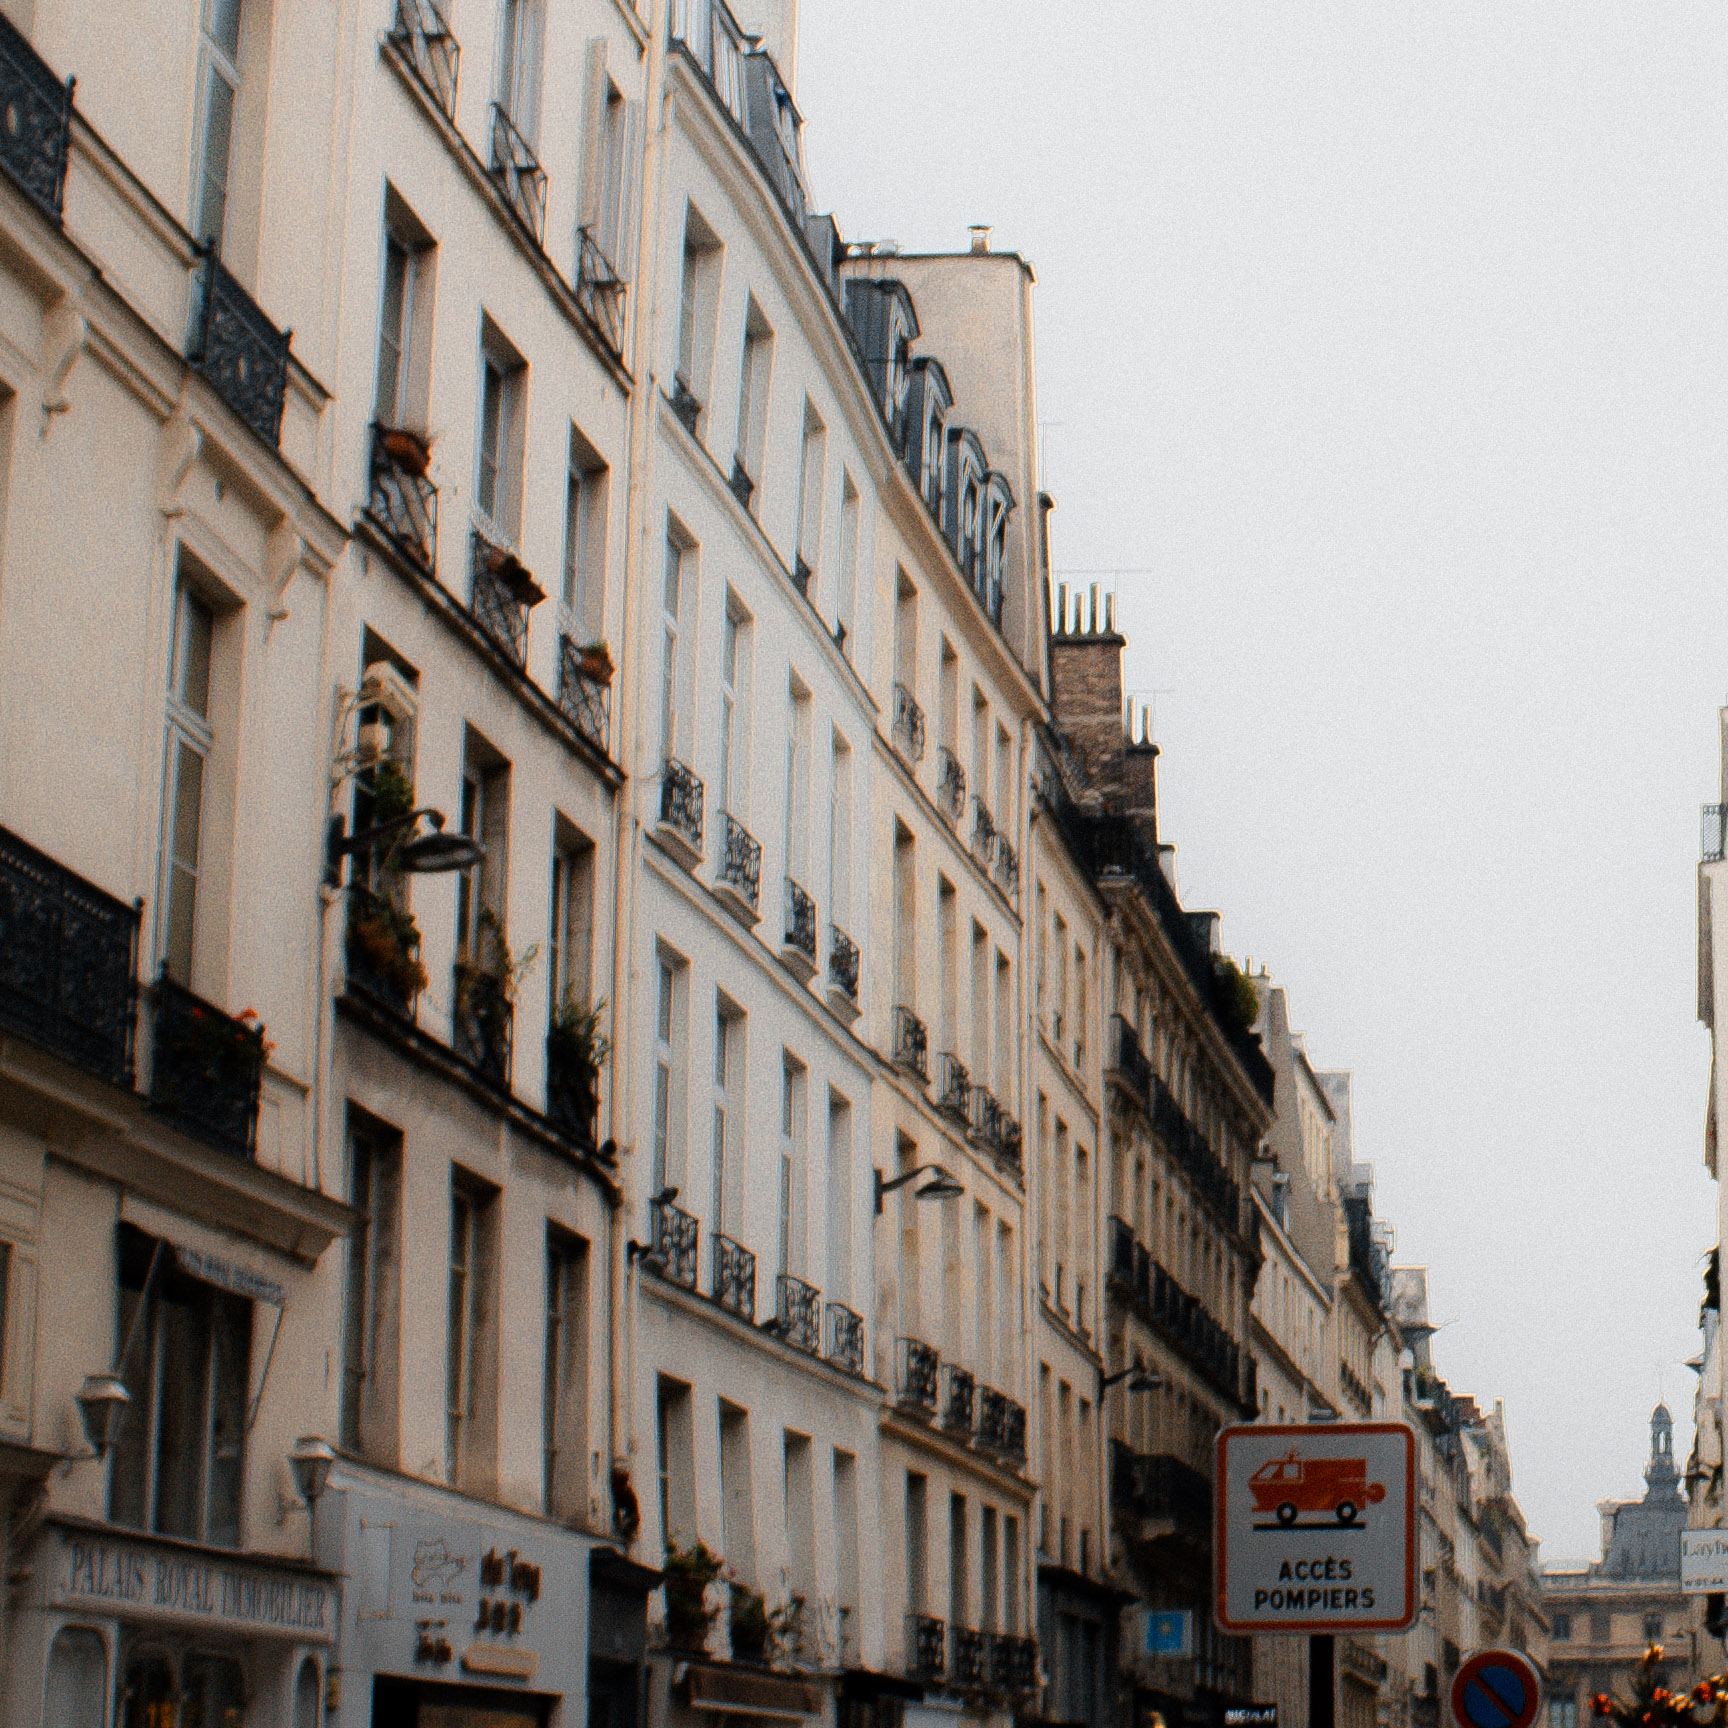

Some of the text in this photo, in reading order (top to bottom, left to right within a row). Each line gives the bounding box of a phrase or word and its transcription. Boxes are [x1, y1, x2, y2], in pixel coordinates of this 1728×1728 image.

[1278, 1555, 1353, 1582] ACCÈS
[71, 1544, 326, 1630] PALAIS ROYAL IMMOBILIER
[1254, 1587, 1375, 1610] POMPIERS
